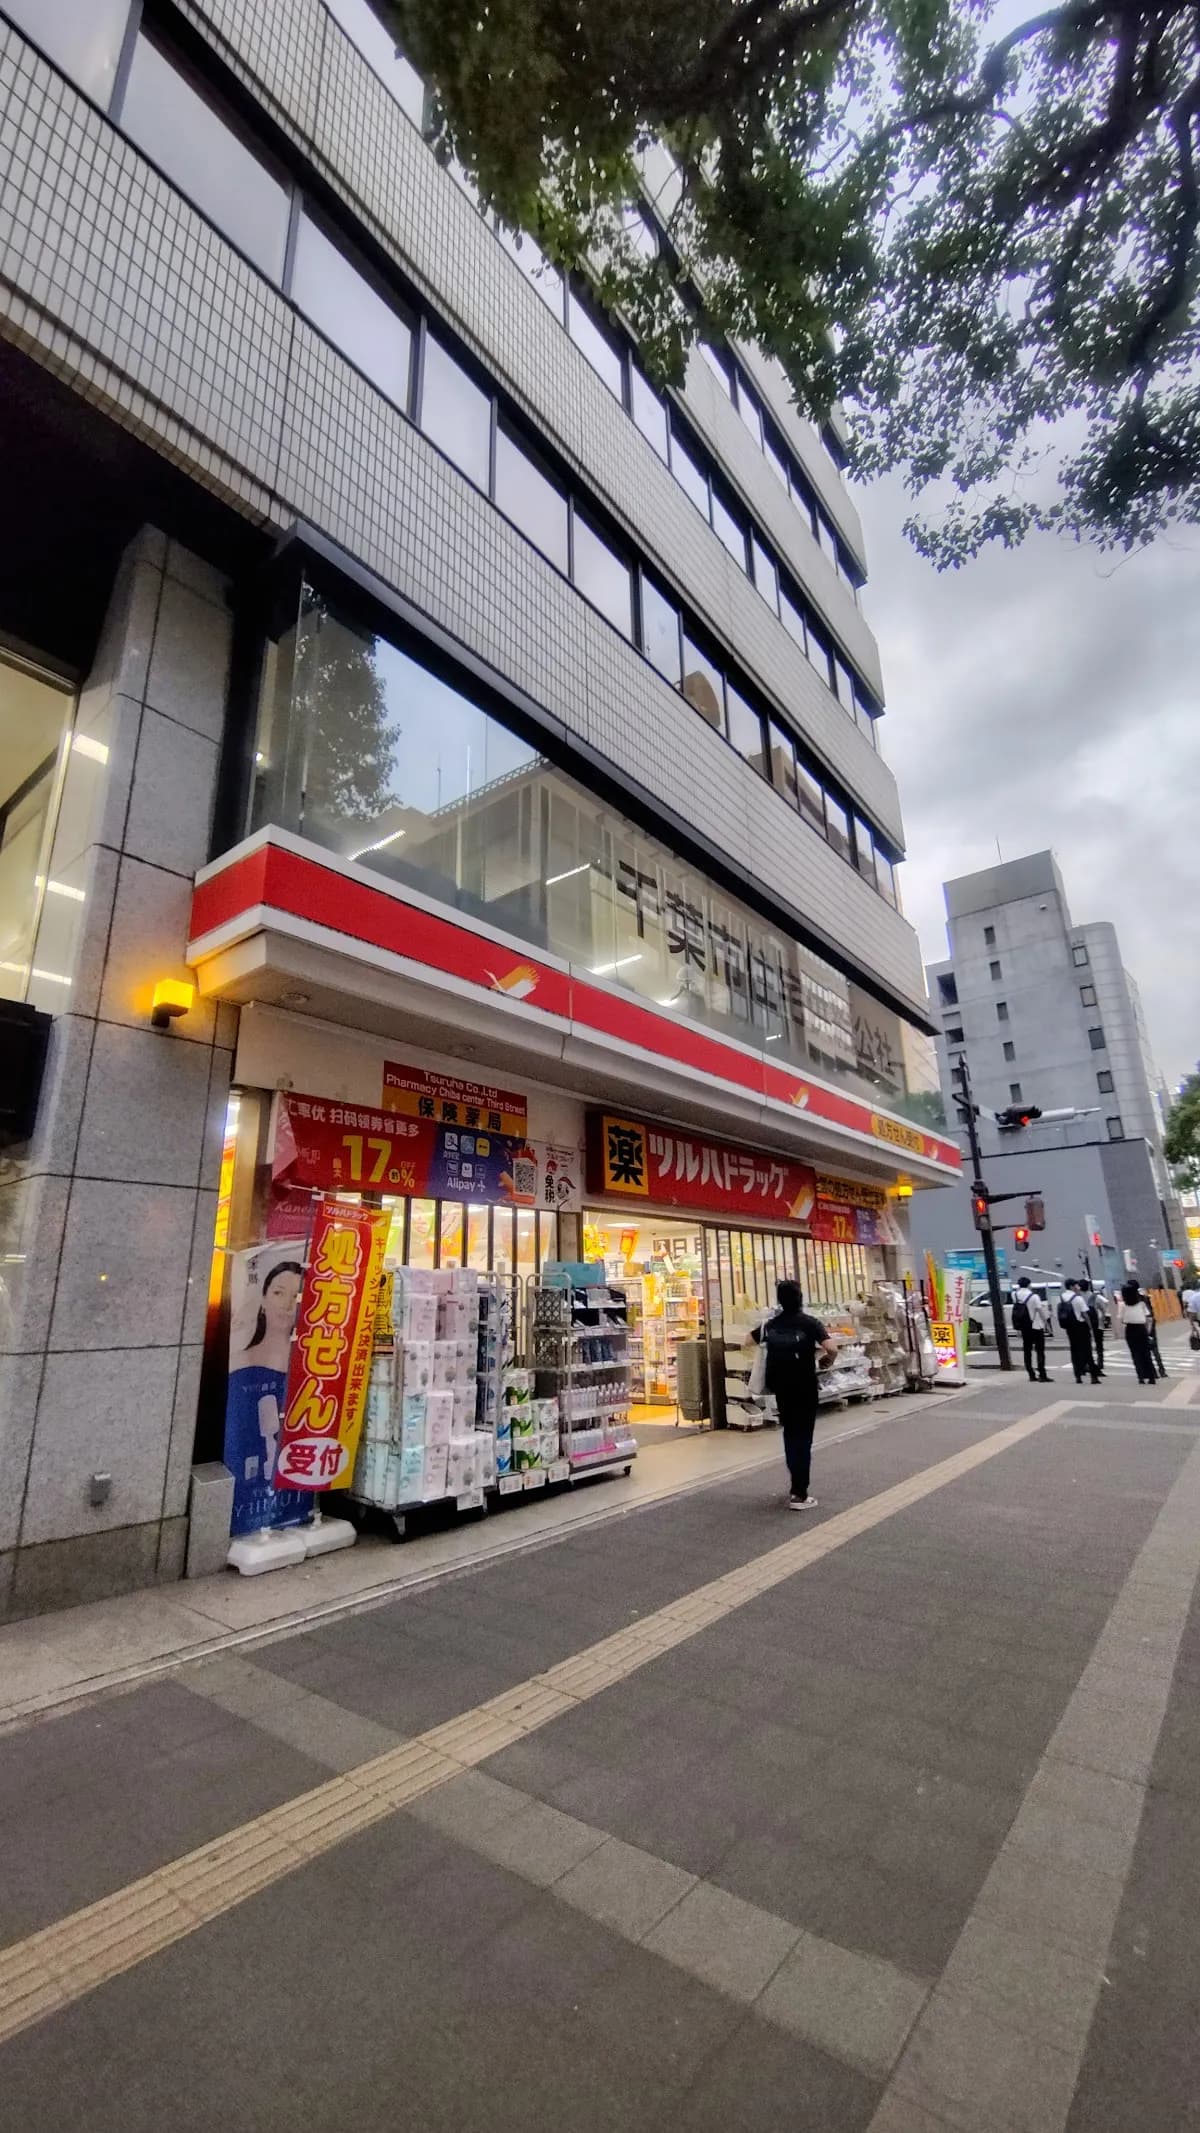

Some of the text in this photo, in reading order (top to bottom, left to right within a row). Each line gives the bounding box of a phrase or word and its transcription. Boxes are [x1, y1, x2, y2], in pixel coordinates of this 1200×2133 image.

[386, 1073, 437, 1096] Pharmacy
[424, 1071, 464, 1091] Tsuruha
[342, 1135, 392, 1183] 17
[608, 1125, 643, 1188] 薬
[650, 1133, 790, 1200] ツルハドラッグ
[284, 1223, 363, 1434] 処方せん
[283, 1443, 344, 1477] 受付
